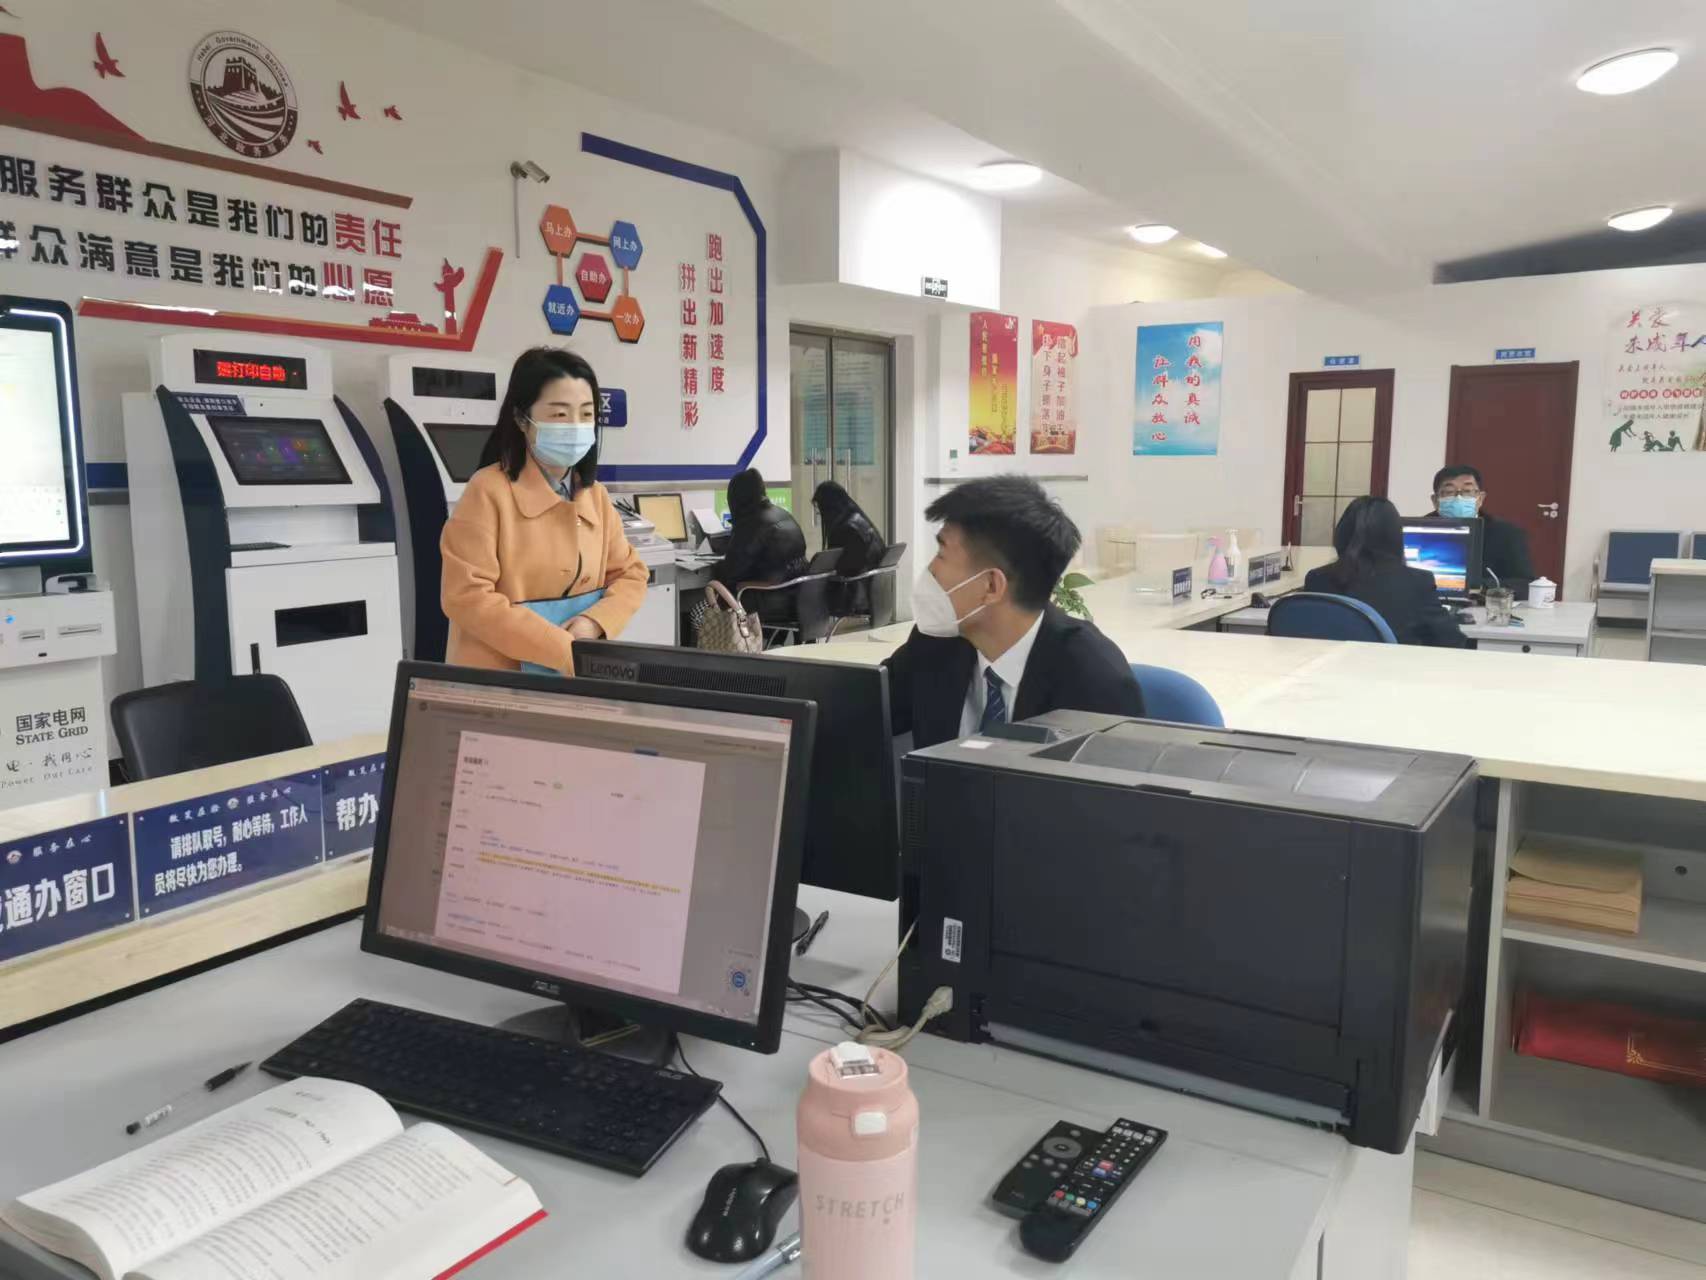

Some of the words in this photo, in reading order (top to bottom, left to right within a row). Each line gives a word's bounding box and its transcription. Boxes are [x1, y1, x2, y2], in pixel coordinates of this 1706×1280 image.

[0, 155, 402, 259] 服务群众是我们的责任
[545, 222, 573, 238] 马上办
[612, 235, 638, 252] 网上办
[580, 269, 608, 285] 自助办
[548, 302, 575, 316] 就近办
[615, 313, 641, 325] 一次办
[708, 233, 725, 393] 跑出加速度
[680, 263, 699, 428] 拼出新精彩
[1184, 335, 1202, 425] 用我的真诚
[1151, 355, 1169, 441] 让群众放心
[16, 706, 87, 732] 国家电网
[15, 731, 55, 746] STATE
[58, 725, 89, 739] GRID
[0, 862, 116, 933] 通办窗口
[815, 1192, 905, 1219] STRETCH
